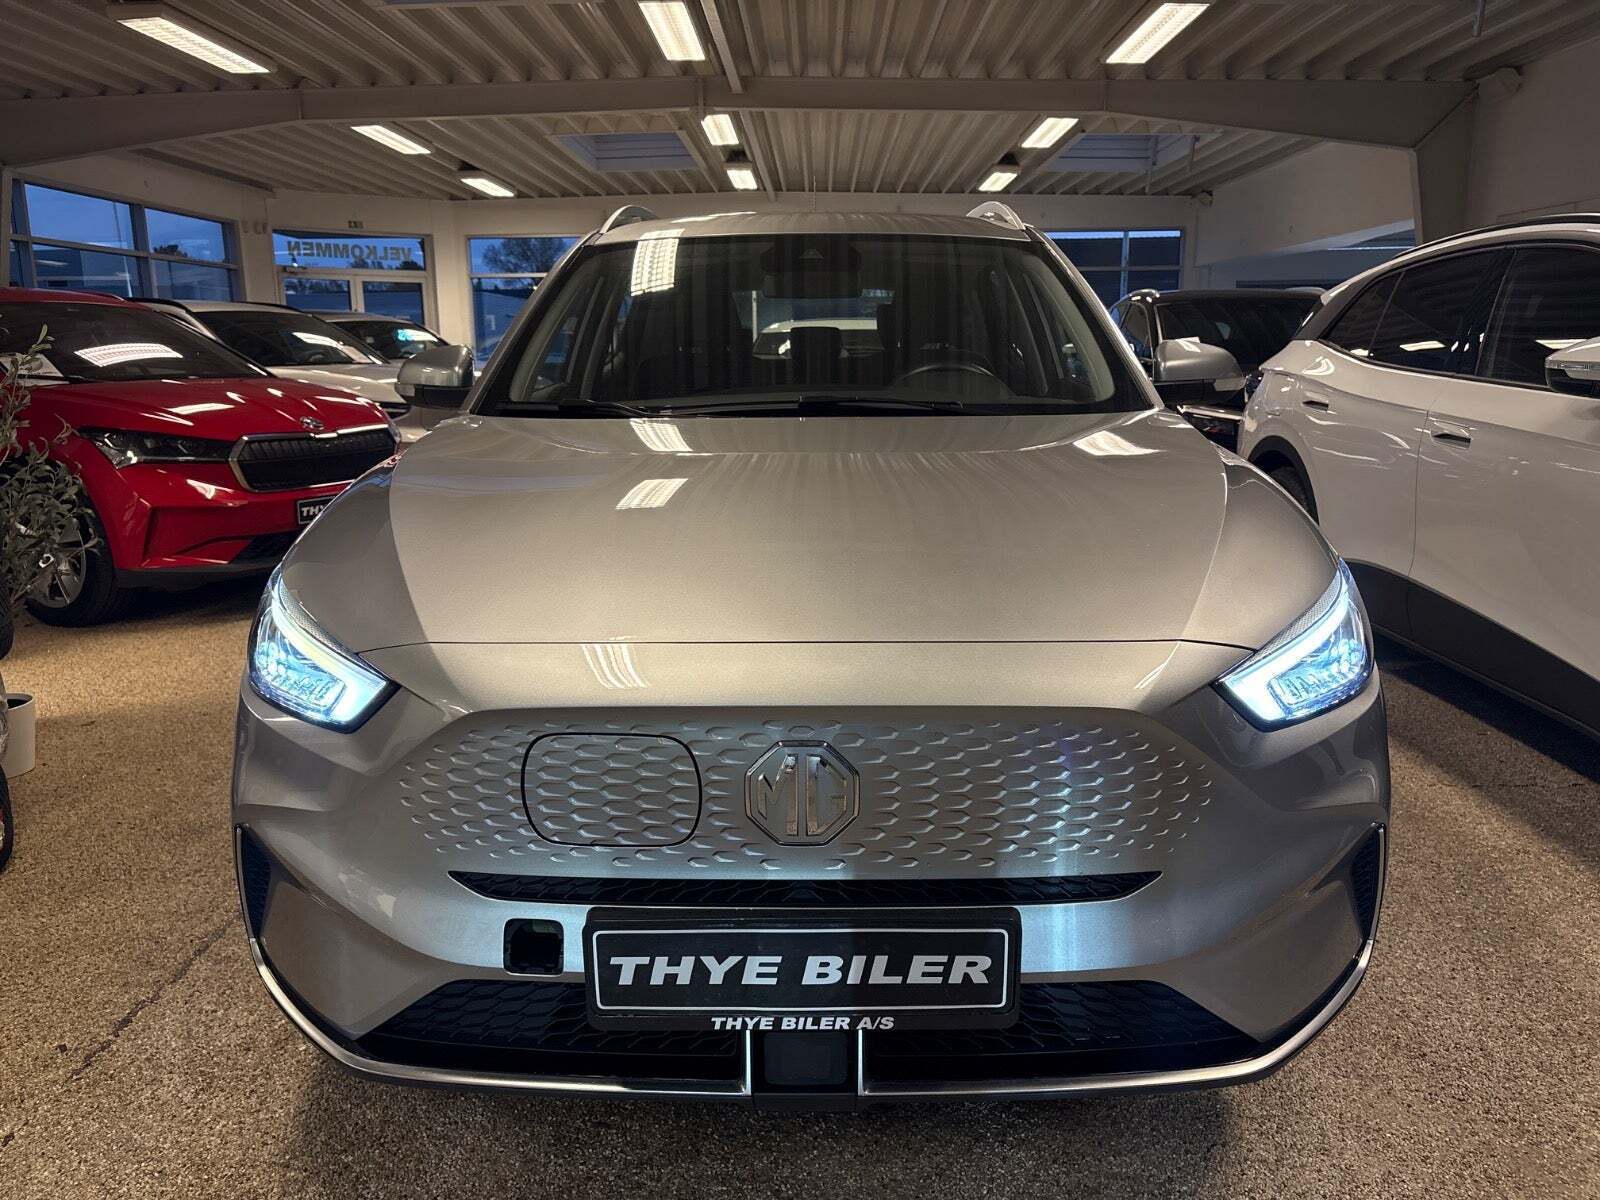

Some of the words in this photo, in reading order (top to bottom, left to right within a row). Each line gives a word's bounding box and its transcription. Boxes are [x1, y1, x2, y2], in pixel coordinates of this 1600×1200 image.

[757, 753, 847, 836] MG
[609, 955, 783, 985] THYE
[801, 955, 992, 985] BILER
[711, 1016, 773, 1030] THYE
[780, 1016, 850, 1030] BILER
[855, 1016, 895, 1030] A/S
